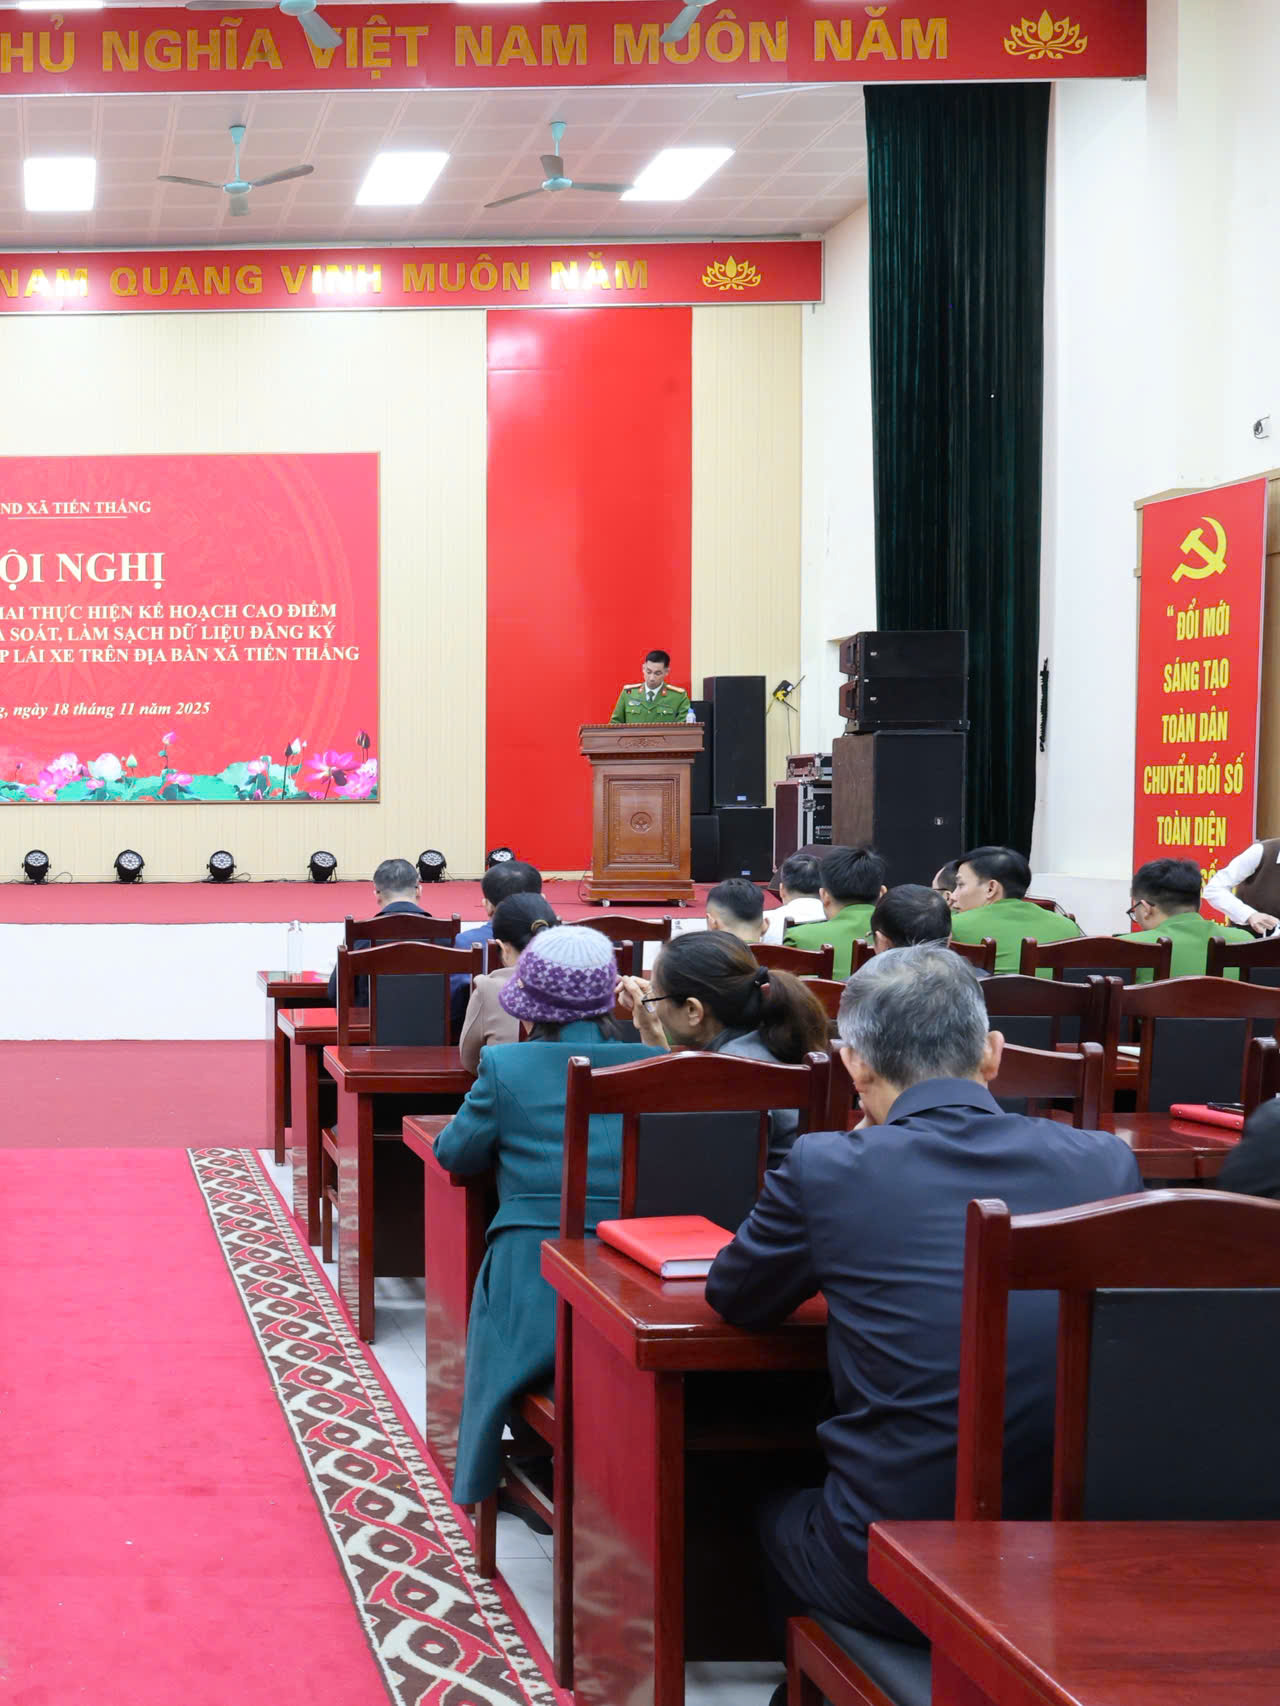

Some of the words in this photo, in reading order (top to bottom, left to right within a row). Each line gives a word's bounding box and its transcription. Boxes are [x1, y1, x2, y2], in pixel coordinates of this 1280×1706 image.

[102, 18, 283, 70] NGHĨA
[304, 15, 428, 78] VIỆT
[456, 24, 587, 64] NAM
[616, 10, 787, 62] MUÔN
[816, 6, 948, 59] NĂM
[110, 264, 263, 298] QUANG
[280, 264, 382, 295] VINH
[402, 253, 531, 294] MUÔN
[550, 250, 649, 292] NĂM
[26, 500, 50, 516] XÃ
[56, 553, 165, 589] NGHỊ
[11, 622, 63, 642] SOÁT,
[68, 624, 108, 640] LÀM
[112, 626, 163, 645] SẠCH
[170, 623, 197, 640] DỮ
[202, 621, 244, 645] LIỆU
[250, 622, 303, 639] ĐĂNG
[307, 618, 335, 638] KÝ
[29, 604, 83, 624] THỰC
[86, 604, 133, 624] HIỆN
[170, 605, 237, 624] HOẠCH
[242, 604, 283, 618] CAO
[1203, 600, 1230, 637] MỚI
[14, 646, 44, 663] LÁI
[50, 649, 74, 662] XE
[79, 644, 130, 662] TRÊN
[134, 648, 167, 665] ĐỊA
[171, 644, 208, 661] BÀN
[214, 645, 239, 661] XÃ
[1164, 657, 1199, 693] SÁNG
[1203, 658, 1229, 695] TẠO
[13, 703, 48, 718] ngày
[53, 703, 69, 715] 18
[73, 702, 115, 718] tháng
[120, 703, 134, 715] 11
[139, 703, 171, 714] năm
[176, 702, 210, 714] 2025
[1162, 708, 1196, 743] TOÀN
[1199, 706, 1228, 741] DÂN
[1144, 753, 1194, 794] CHUYỂN
[1197, 752, 1220, 794] ĐỔI
[1224, 753, 1244, 794] SỐ
[1157, 810, 1190, 845] TOÀN
[1194, 811, 1226, 853] DIỆN
